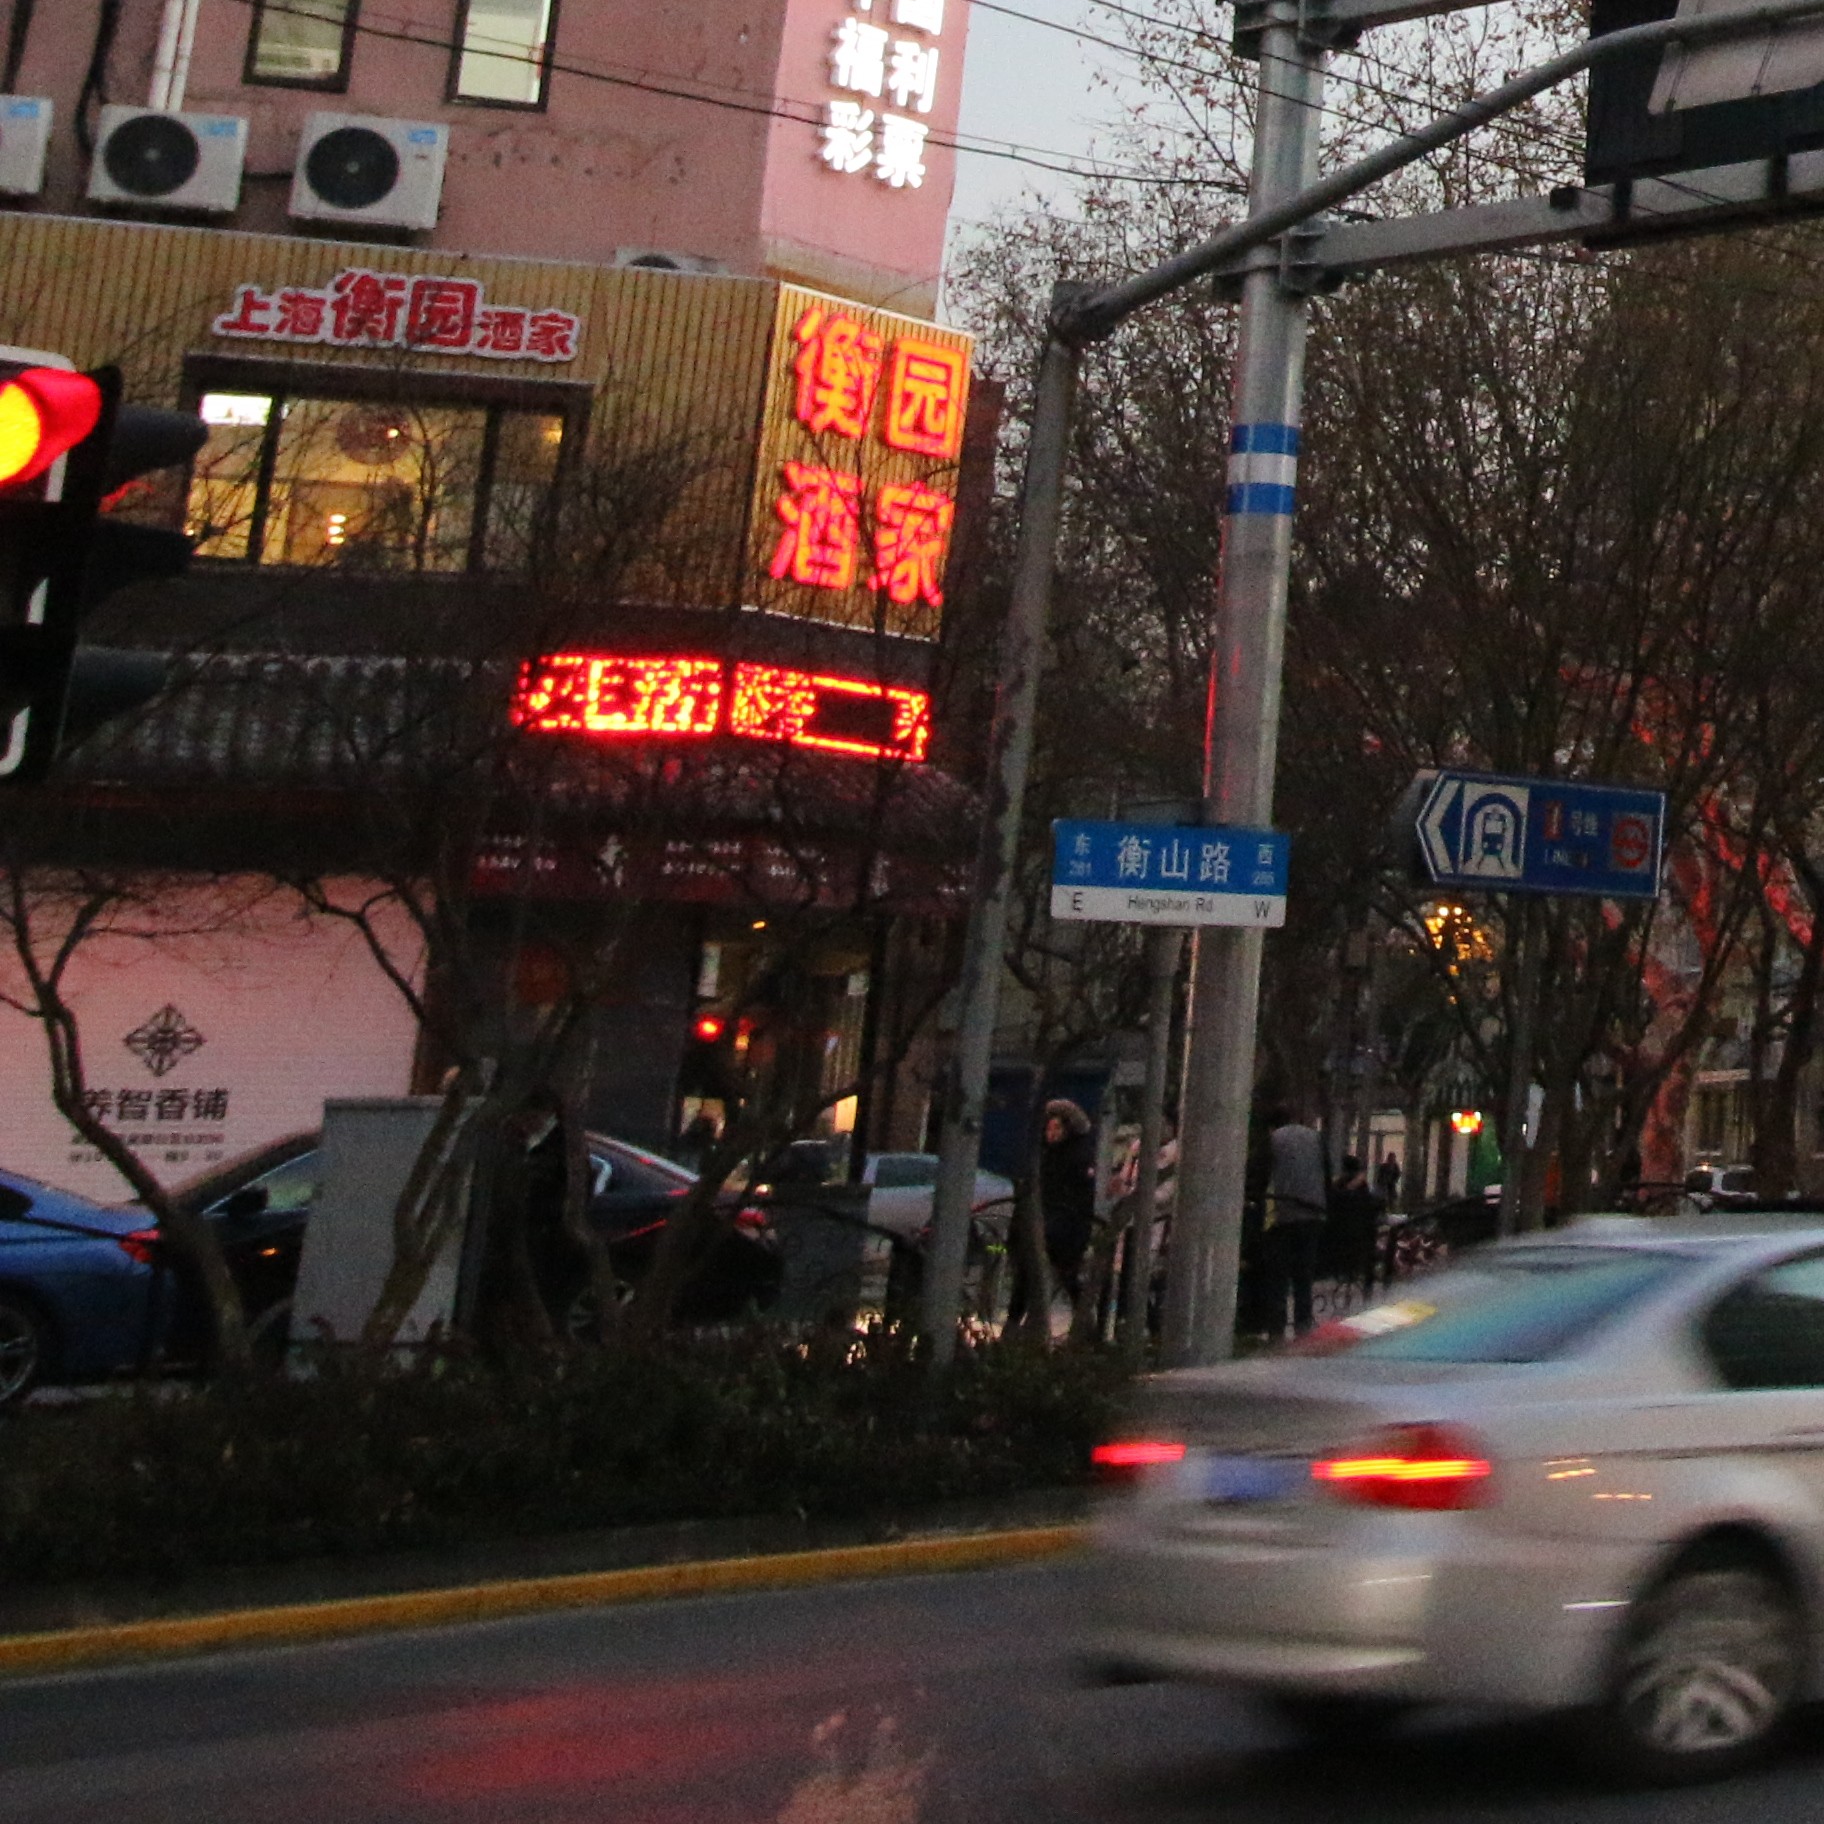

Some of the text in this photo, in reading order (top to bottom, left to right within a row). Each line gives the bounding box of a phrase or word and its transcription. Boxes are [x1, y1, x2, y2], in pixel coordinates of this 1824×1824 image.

[836, 17, 939, 113] 福利
[824, 100, 929, 188] 彩票
[208, 271, 577, 358] 上海衡园酒家
[795, 307, 967, 458] 衡园
[770, 460, 954, 607] 酒家
[1074, 833, 1091, 856] 东
[1117, 835, 1231, 884] 衡山路
[1258, 843, 1275, 865] 西
[1072, 891, 1083, 913] E
[1127, 895, 1214, 914] Hengshan Rd
[1255, 900, 1271, 919] W
